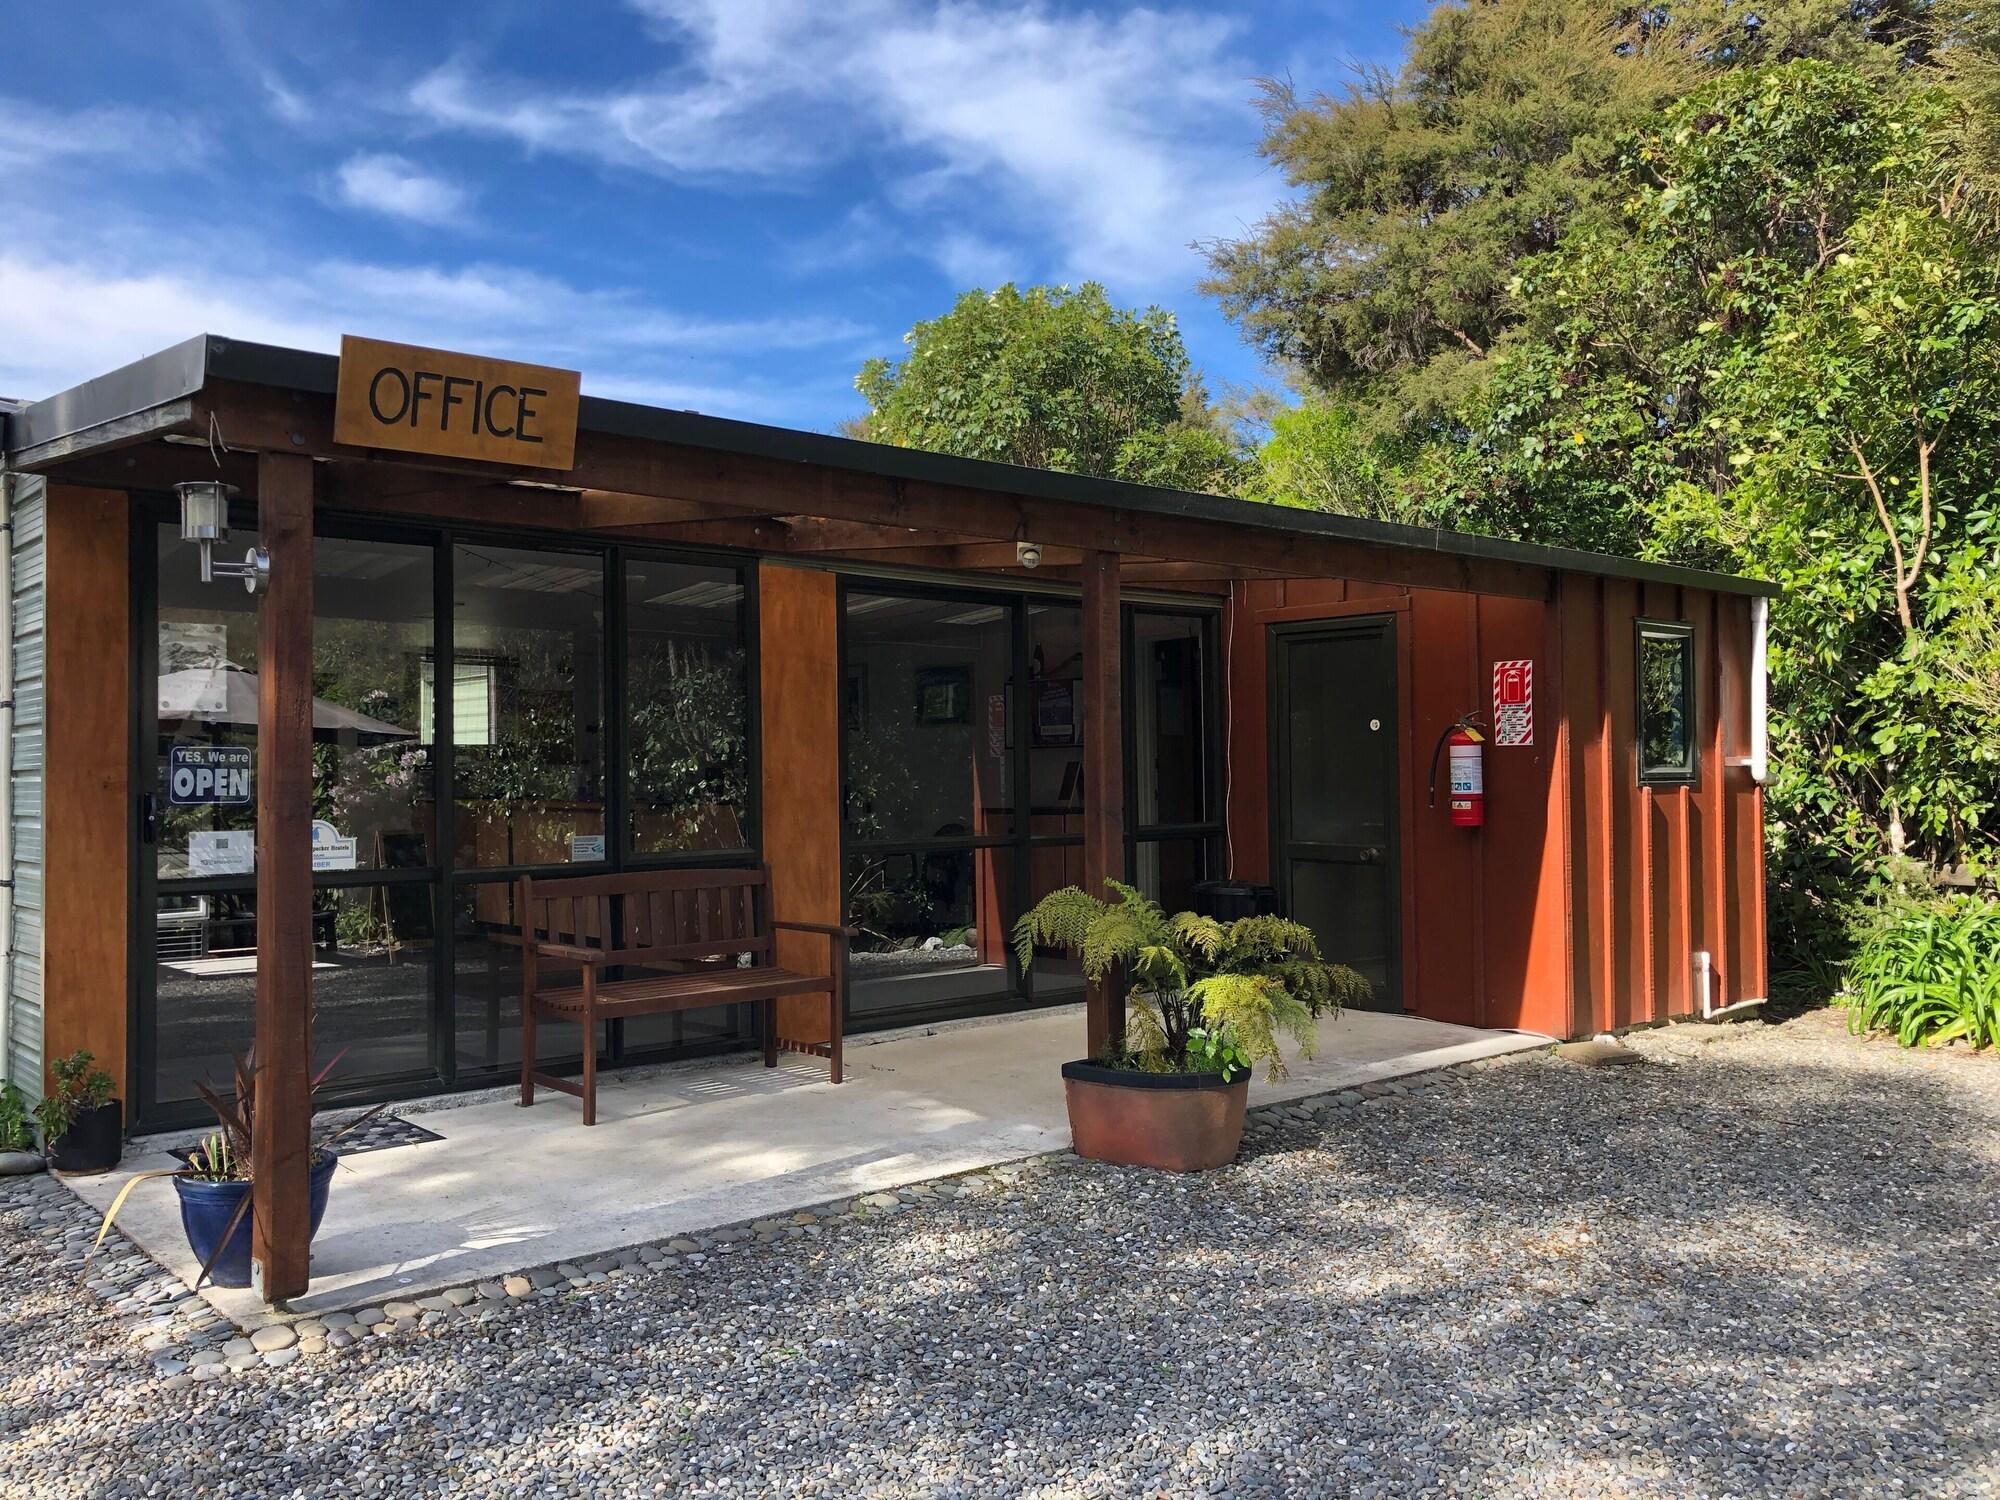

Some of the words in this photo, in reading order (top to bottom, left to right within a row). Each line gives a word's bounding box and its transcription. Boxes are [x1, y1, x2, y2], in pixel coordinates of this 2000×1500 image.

[369, 367, 547, 443] OFFICE
[176, 751, 204, 764] YES,
[208, 751, 226, 762] We
[229, 754, 249, 762] are
[173, 767, 249, 797] OPEN
